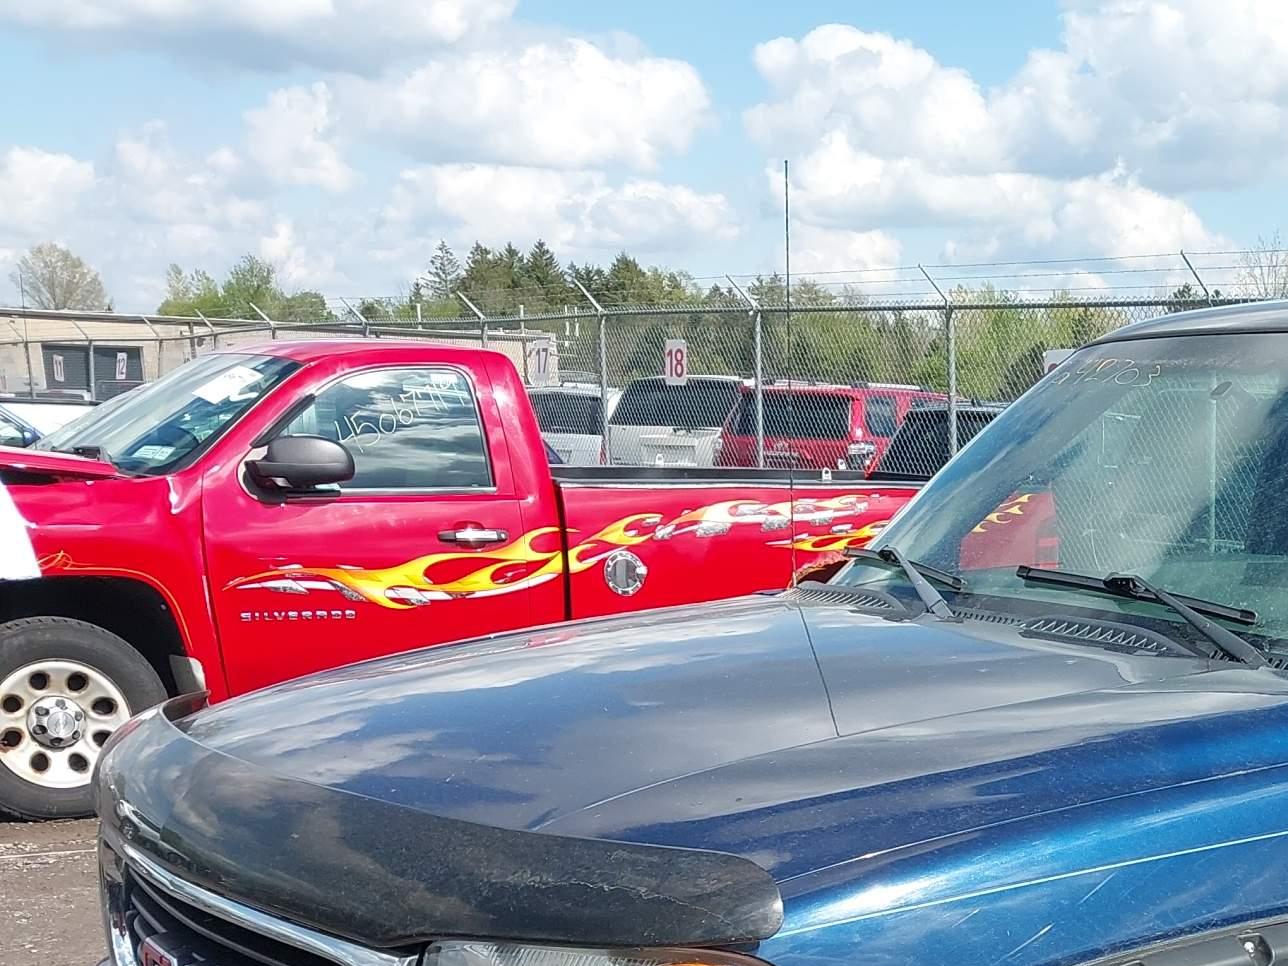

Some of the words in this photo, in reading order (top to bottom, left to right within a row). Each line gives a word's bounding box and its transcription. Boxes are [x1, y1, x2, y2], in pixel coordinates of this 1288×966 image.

[117, 358, 126, 376] 12
[535, 348, 548, 374] 17
[666, 348, 684, 378] 18
[240, 609, 356, 622] SILVERADO
